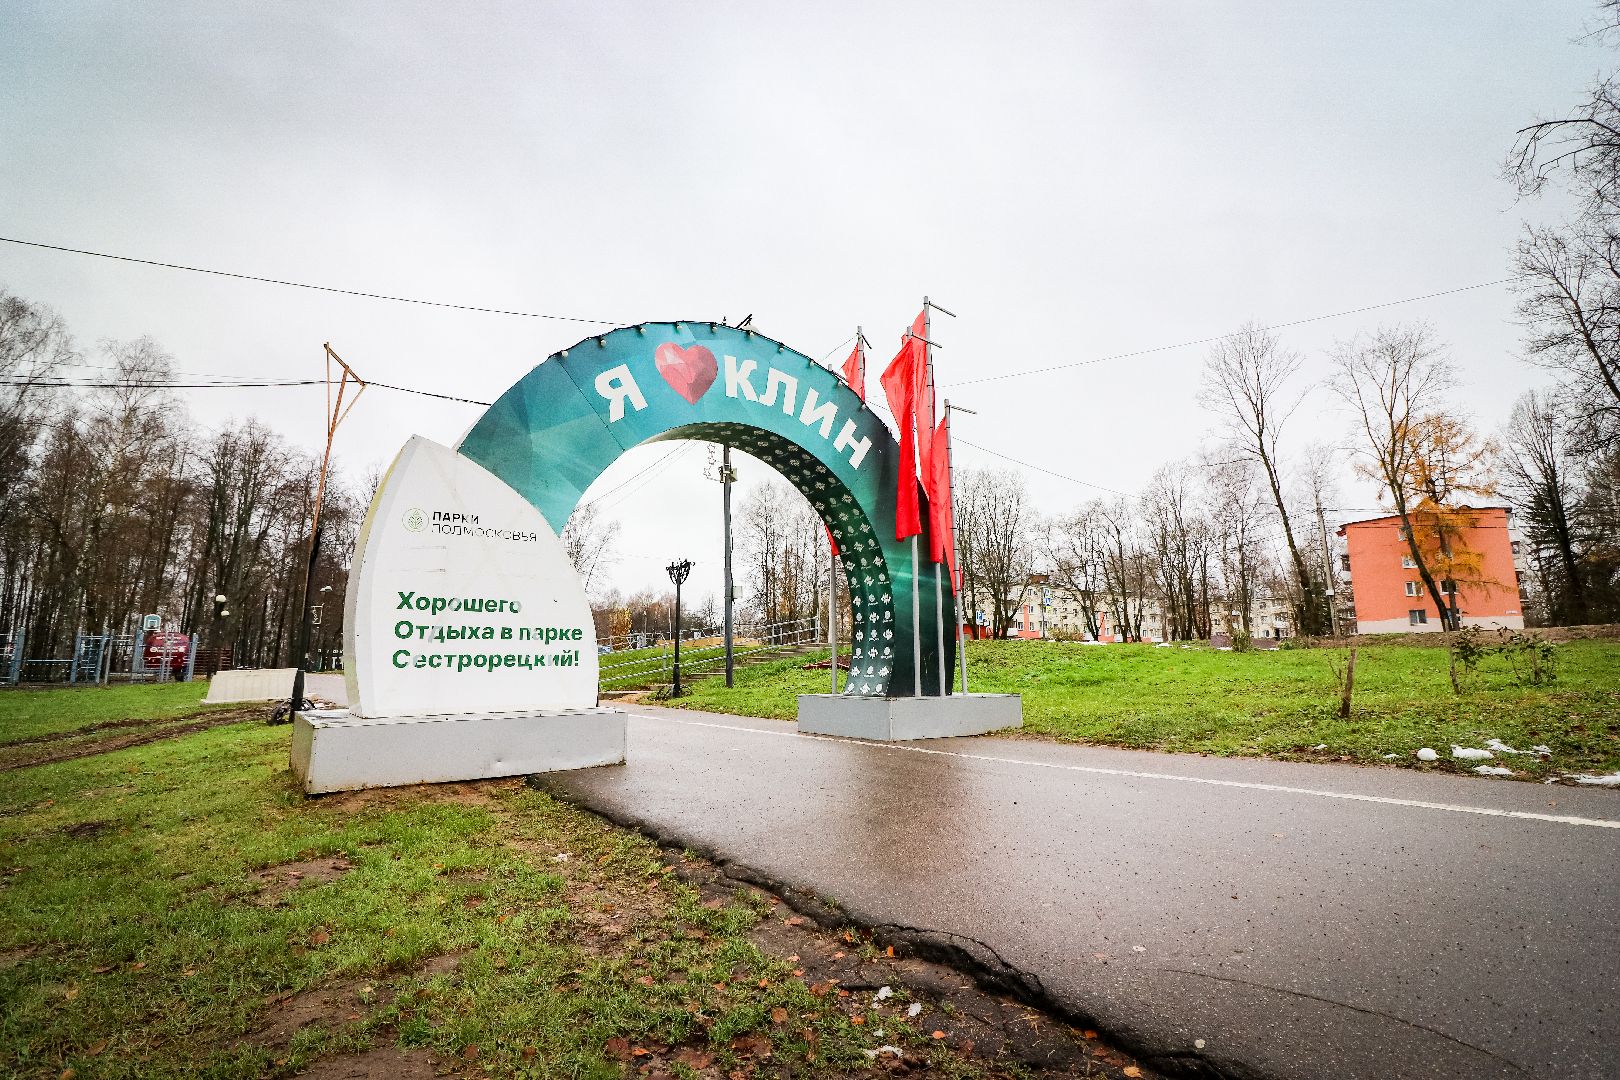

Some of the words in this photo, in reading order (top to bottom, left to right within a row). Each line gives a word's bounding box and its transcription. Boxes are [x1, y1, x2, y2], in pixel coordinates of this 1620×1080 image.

[594, 364, 648, 423] Я
[724, 355, 873, 470] КЛИН
[432, 512, 479, 524] ПАРКИ
[396, 591, 522, 615] Хорошего
[394, 620, 495, 643] Отдыха
[500, 626, 513, 640] в
[518, 626, 583, 645] парке
[392, 649, 580, 672] Сестрорецкий!
